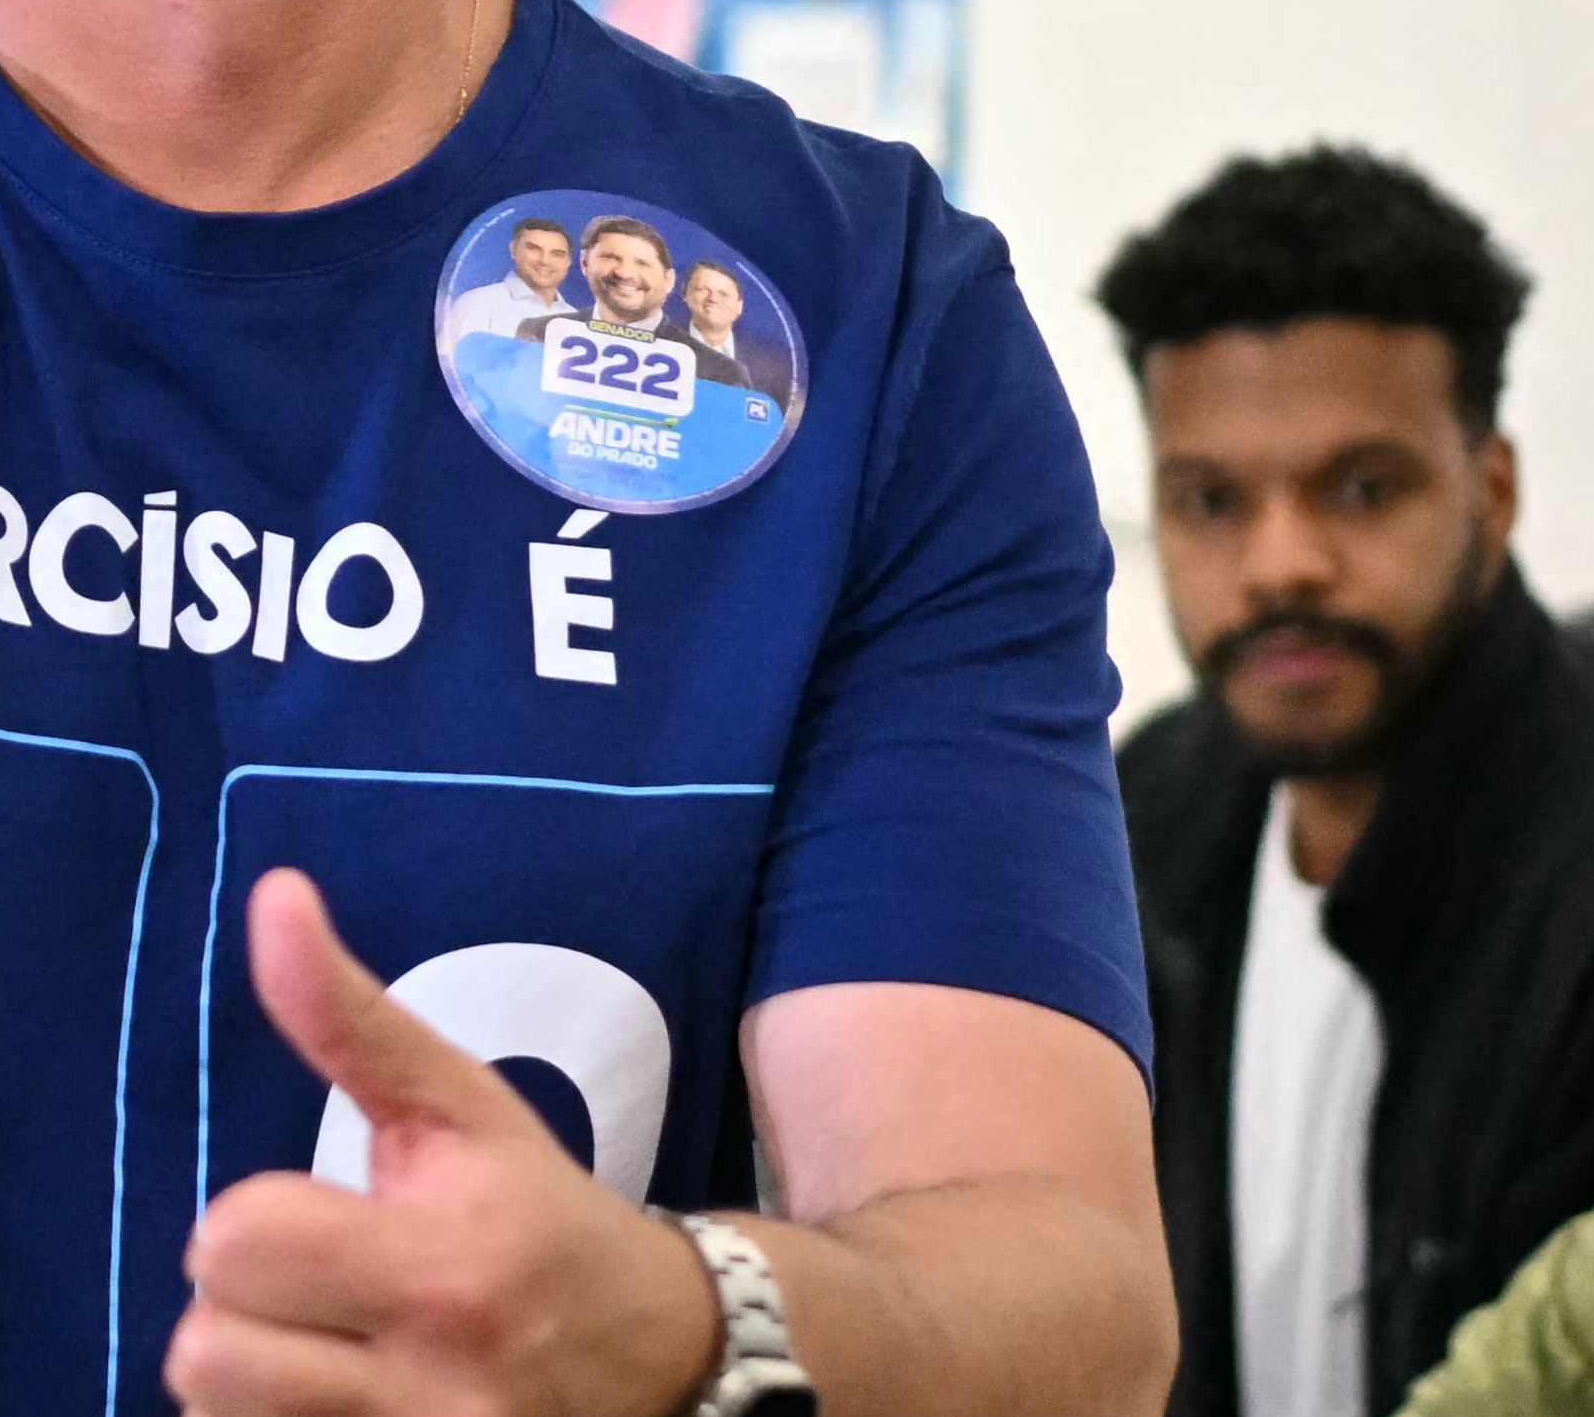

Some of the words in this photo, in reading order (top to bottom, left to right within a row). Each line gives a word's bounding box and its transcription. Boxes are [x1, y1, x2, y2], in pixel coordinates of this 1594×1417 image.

[589, 320, 654, 342] SENADOR
[558, 336, 680, 400] 222
[567, 442, 594, 457] DO
[596, 446, 658, 470] PRADO
[529, 509, 617, 685] É
